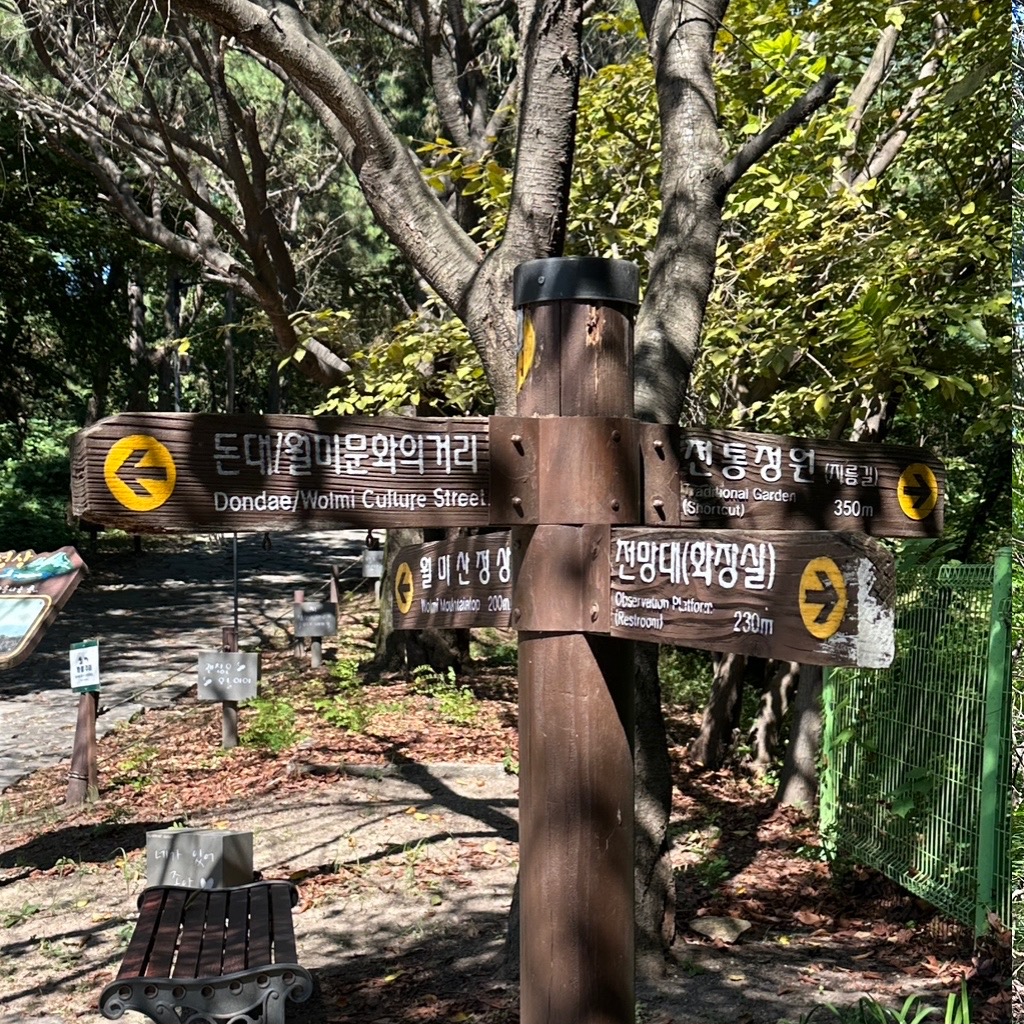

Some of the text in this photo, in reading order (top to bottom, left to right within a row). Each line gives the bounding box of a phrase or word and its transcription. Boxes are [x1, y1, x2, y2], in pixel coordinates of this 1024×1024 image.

[213, 432, 477, 476] 돈대/월미문화의거리
[684, 439, 878, 486] 전통정원 (지름길)
[214, 489, 354, 512] Dondae/Wolmi
[362, 489, 426, 510] Culture
[753, 487, 796, 503] Garden
[682, 498, 873, 518] (Shortcut) 350m
[615, 539, 775, 589] 전망대(화장실)
[420, 598, 439, 613] Wolmi
[614, 592, 713, 614] Observation Platform
[614, 608, 774, 635] (Restroom) 230m
